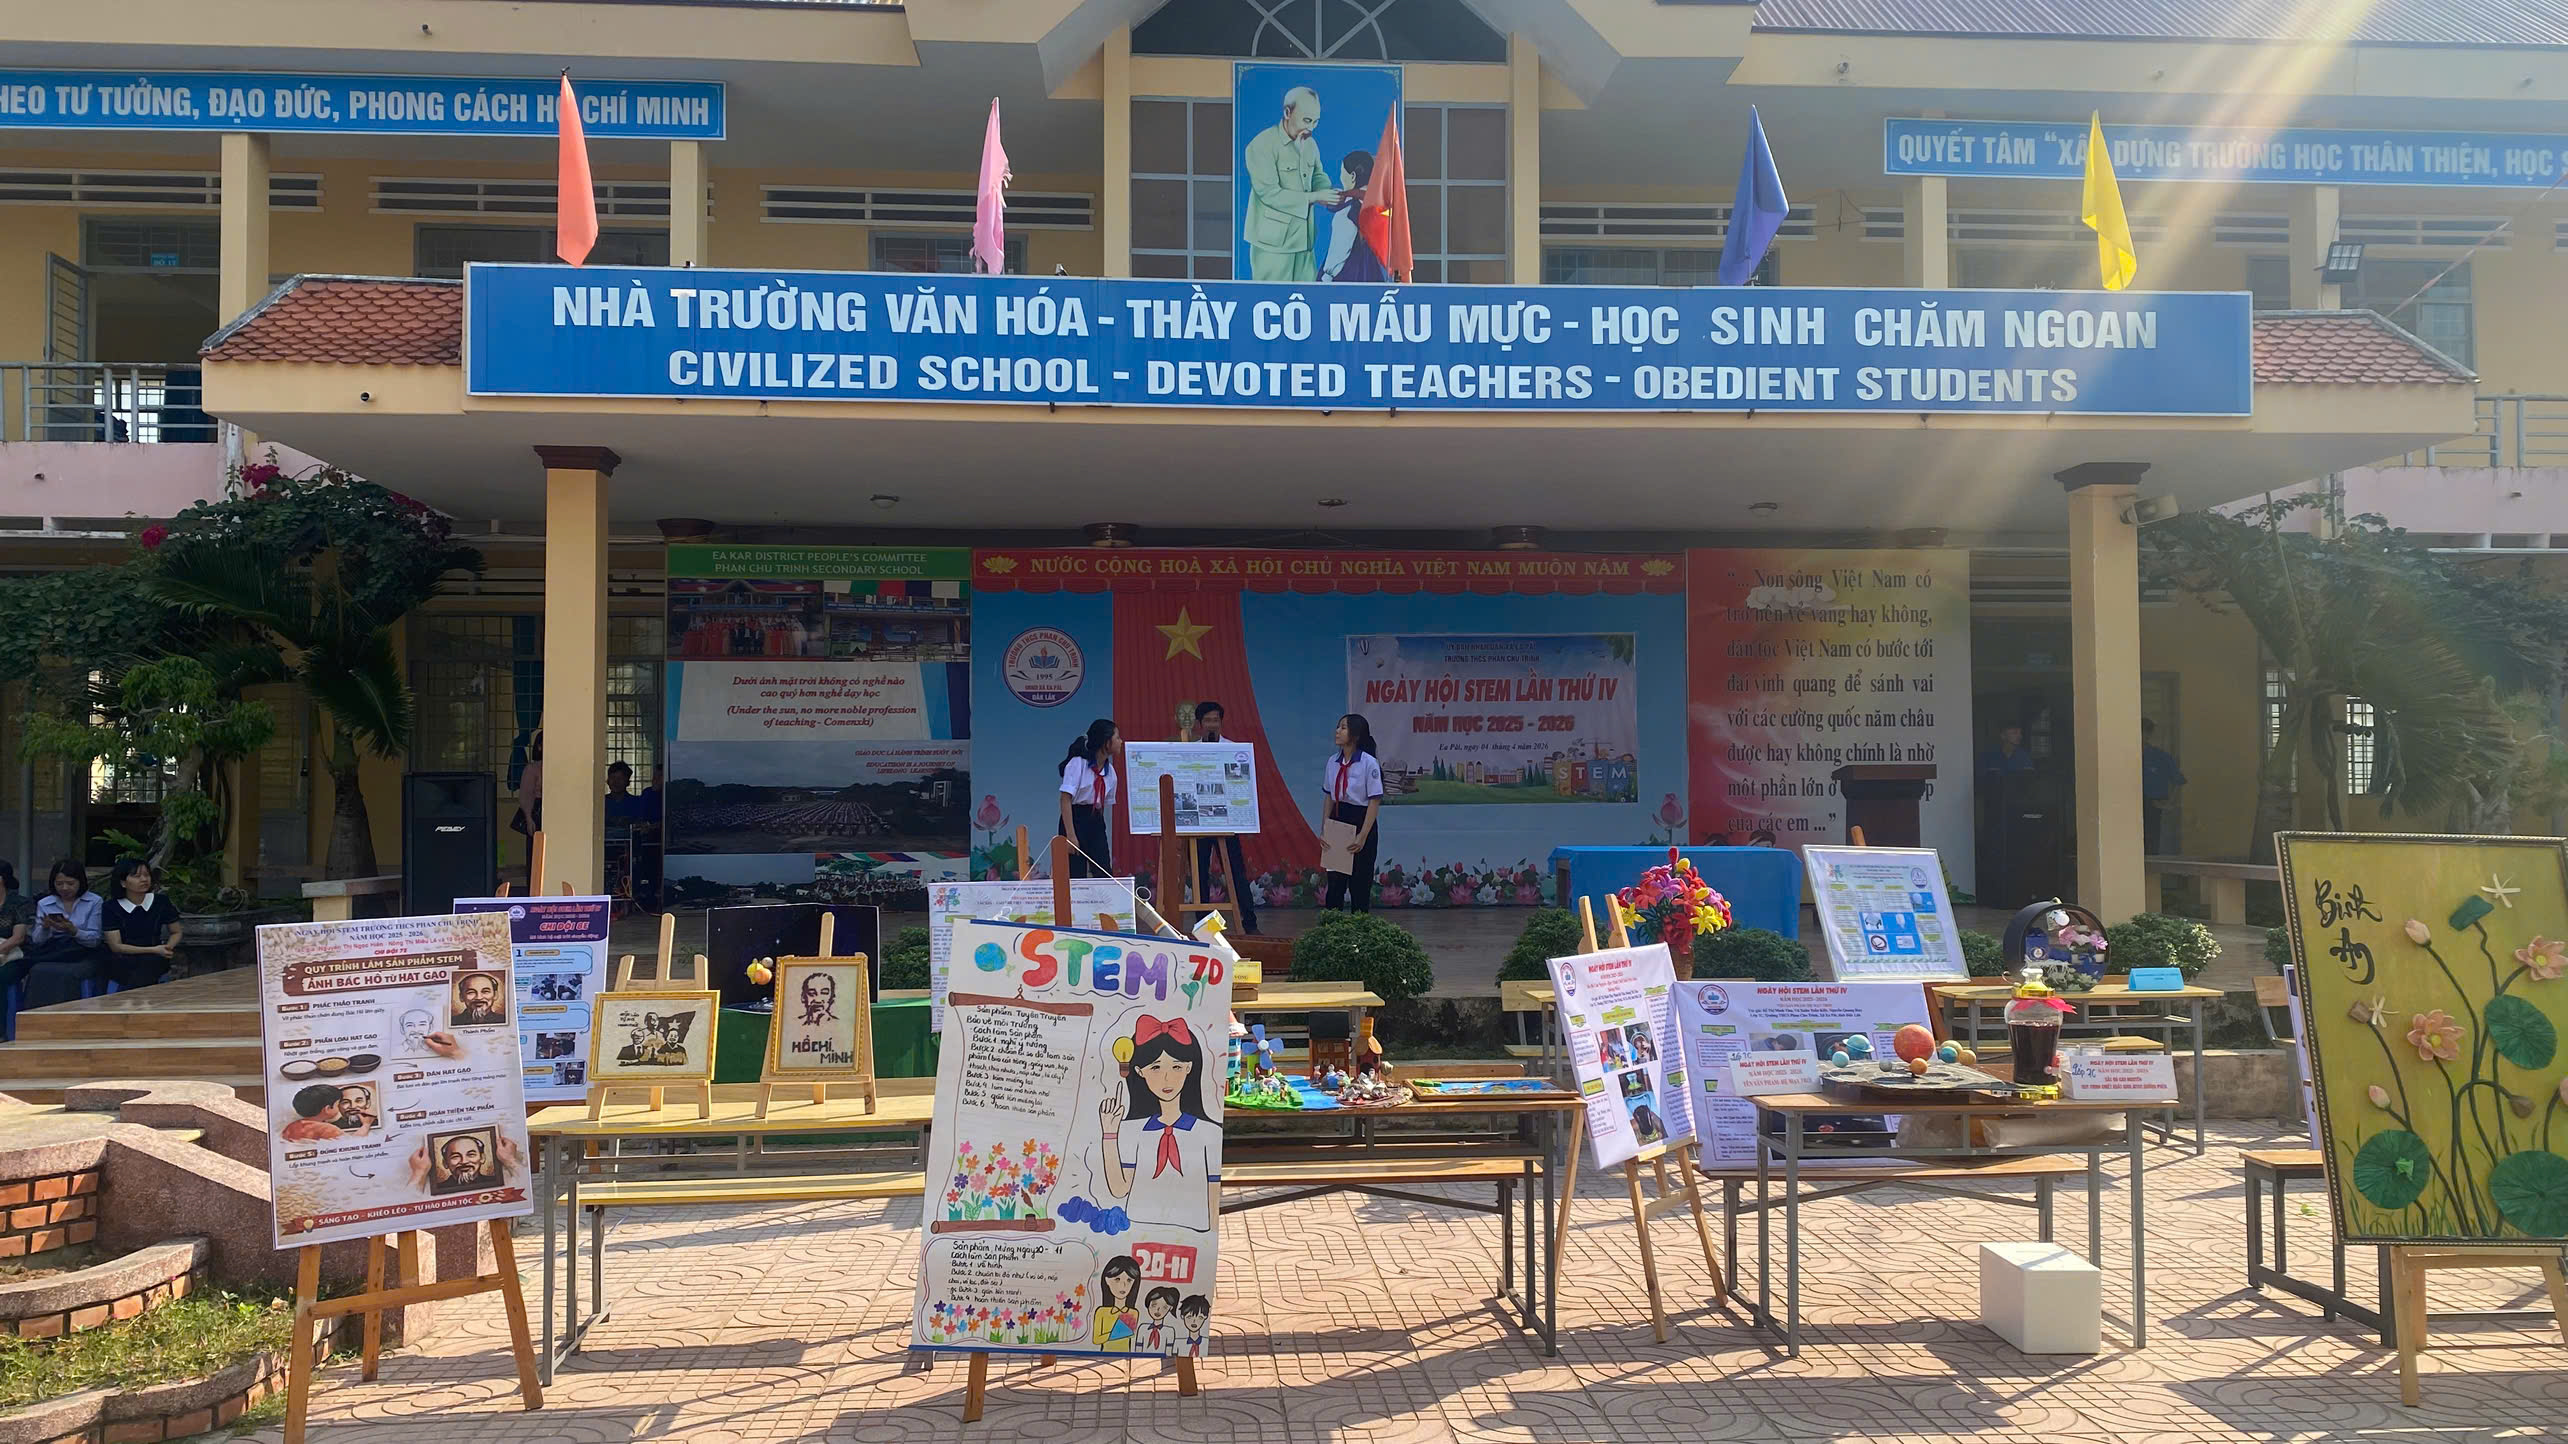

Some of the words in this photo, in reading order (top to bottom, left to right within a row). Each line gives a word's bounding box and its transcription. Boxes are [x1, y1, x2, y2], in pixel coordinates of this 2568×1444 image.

[55, 83, 93, 114] TƯ
[98, 77, 200, 120] TƯỞNG,
[208, 87, 265, 123] ĐẠO
[274, 83, 340, 122] ĐỨC,
[349, 90, 444, 121] PHONG
[454, 87, 527, 122] CÁCH
[537, 95, 561, 122] H
[583, 89, 628, 124] CHÍ
[636, 97, 709, 125] MINH
[1898, 128, 1975, 163] QUYẾT
[1983, 133, 2036, 165] TÂM
[2114, 138, 2182, 172] DỰNG
[2190, 139, 2286, 169] TRƯỜNG
[2294, 144, 2343, 176] HỌC
[2350, 140, 2414, 172] THÂN
[2421, 142, 2498, 179] THIỆN,
[2505, 148, 2553, 181] HỌC
[552, 279, 656, 328] NHÀ
[671, 278, 867, 332] TRƯỜNG
[885, 286, 977, 335] VĂN
[995, 286, 1090, 337] HÓA
[1126, 285, 1237, 341] THẦY
[1252, 293, 1313, 342] CÔ
[1329, 288, 1433, 344] MẪU
[1449, 299, 1551, 352] MỰC
[1592, 305, 1680, 353] HỌC
[1710, 306, 1826, 345] SINH
[1854, 301, 1986, 348] CHĂM
[2004, 309, 2157, 349] NGOAN
[669, 350, 899, 390] CIVILIZED
[918, 354, 1099, 394] SCHOOL
[1147, 360, 1346, 398] DEVOTED
[1365, 364, 1593, 400] TEACHERS
[1634, 365, 1840, 401] OBEDIENT
[1856, 367, 2078, 403] STUDENTS
[712, 551, 727, 561] EA
[730, 552, 752, 561] KAR
[755, 552, 806, 561] DISTRICT
[862, 552, 928, 562] COMMITTEE
[1030, 556, 1088, 574] NƯỚC
[1096, 555, 1152, 575] CỘNG
[1160, 556, 1203, 574] HOÀ
[1209, 556, 1240, 574] XÃ
[1246, 557, 1285, 576] HỘI
[1290, 555, 1332, 574] CHỦ
[1341, 558, 1405, 576] NGHĨA
[1411, 558, 1460, 577] VIỆT
[1467, 560, 1511, 576] NAM
[1519, 558, 1577, 576] MUÔN
[1584, 558, 1630, 576] NĂM
[715, 564, 746, 573] PHAN
[749, 564, 773, 573] CHU
[776, 564, 809, 573] TRINH
[812, 565, 878, 574] SECONDARY
[880, 565, 925, 574] SCHOOL
[1831, 569, 1863, 591] Việt
[1872, 569, 1906, 588] Nam
[1915, 570, 1931, 588] có
[1851, 606, 1877, 628] hay
[1882, 604, 1932, 628] không,
[1783, 639, 1814, 661] Việt
[1819, 639, 1852, 657] Nam
[1855, 639, 1871, 657] có
[1876, 639, 1910, 657] bước
[1914, 638, 1934, 657] tới
[759, 676, 777, 685] ánh
[1037, 673, 1053, 681] 1995
[1366, 673, 1421, 704] NGÀY
[1424, 673, 1459, 709] HỘI
[1463, 679, 1511, 703] STEM
[1515, 667, 1553, 703] LẦN
[1558, 672, 1597, 702] THỨ
[1599, 677, 1619, 701] IV
[1793, 677, 1837, 697] quang
[1844, 668, 1862, 692] để
[1870, 673, 1904, 692] sánh
[1913, 673, 1934, 692] vai
[779, 688, 798, 699] quý
[843, 689, 862, 699] dạy
[862, 689, 881, 698] học
[727, 705, 761, 716] (Under
[762, 706, 778, 714] the
[778, 707, 798, 715] sun,
[840, 705, 867, 714] noble
[868, 705, 917, 716] profession
[1727, 708, 1748, 727] với
[1753, 708, 1776, 727] các
[1780, 708, 1824, 732] cường
[1828, 705, 1861, 731] quốc
[1865, 709, 1897, 727] năm
[1900, 708, 1935, 727] châu
[763, 717, 775, 728] of
[775, 718, 816, 728] teaching
[1413, 713, 1450, 734] NĂM
[1452, 715, 1484, 736] HỌC
[1487, 715, 1524, 732] 2025
[1538, 715, 1575, 732] 2026
[1727, 743, 1762, 765] được
[1767, 743, 1792, 766] hay
[1797, 743, 1842, 766] không
[1846, 743, 1884, 762] chính
[1889, 742, 1902, 762] là
[1907, 743, 1935, 762] nhờ
[1559, 765, 1628, 780] STEM
[1728, 778, 1757, 798] một
[1761, 774, 1797, 801] phần
[1801, 777, 1825, 797] lớn
[304, 964, 326, 975] QUY
[385, 957, 405, 969] SẢN
[436, 954, 463, 965] STEM
[1021, 930, 1168, 1001] STEM
[1188, 955, 1224, 986] 7D
[308, 975, 333, 989] ẢNH
[336, 974, 361, 987] BÁC
[399, 972, 420, 983] HẠT
[423, 969, 448, 983] GẠO
[318, 1215, 341, 1226] SÁNG
[342, 1213, 359, 1224] TẠO
[367, 1209, 390, 1219] KHÉO
[391, 1207, 407, 1217] LÉO
[459, 1197, 474, 1207] TỘC
[1136, 1249, 1190, 1280] 20-11
